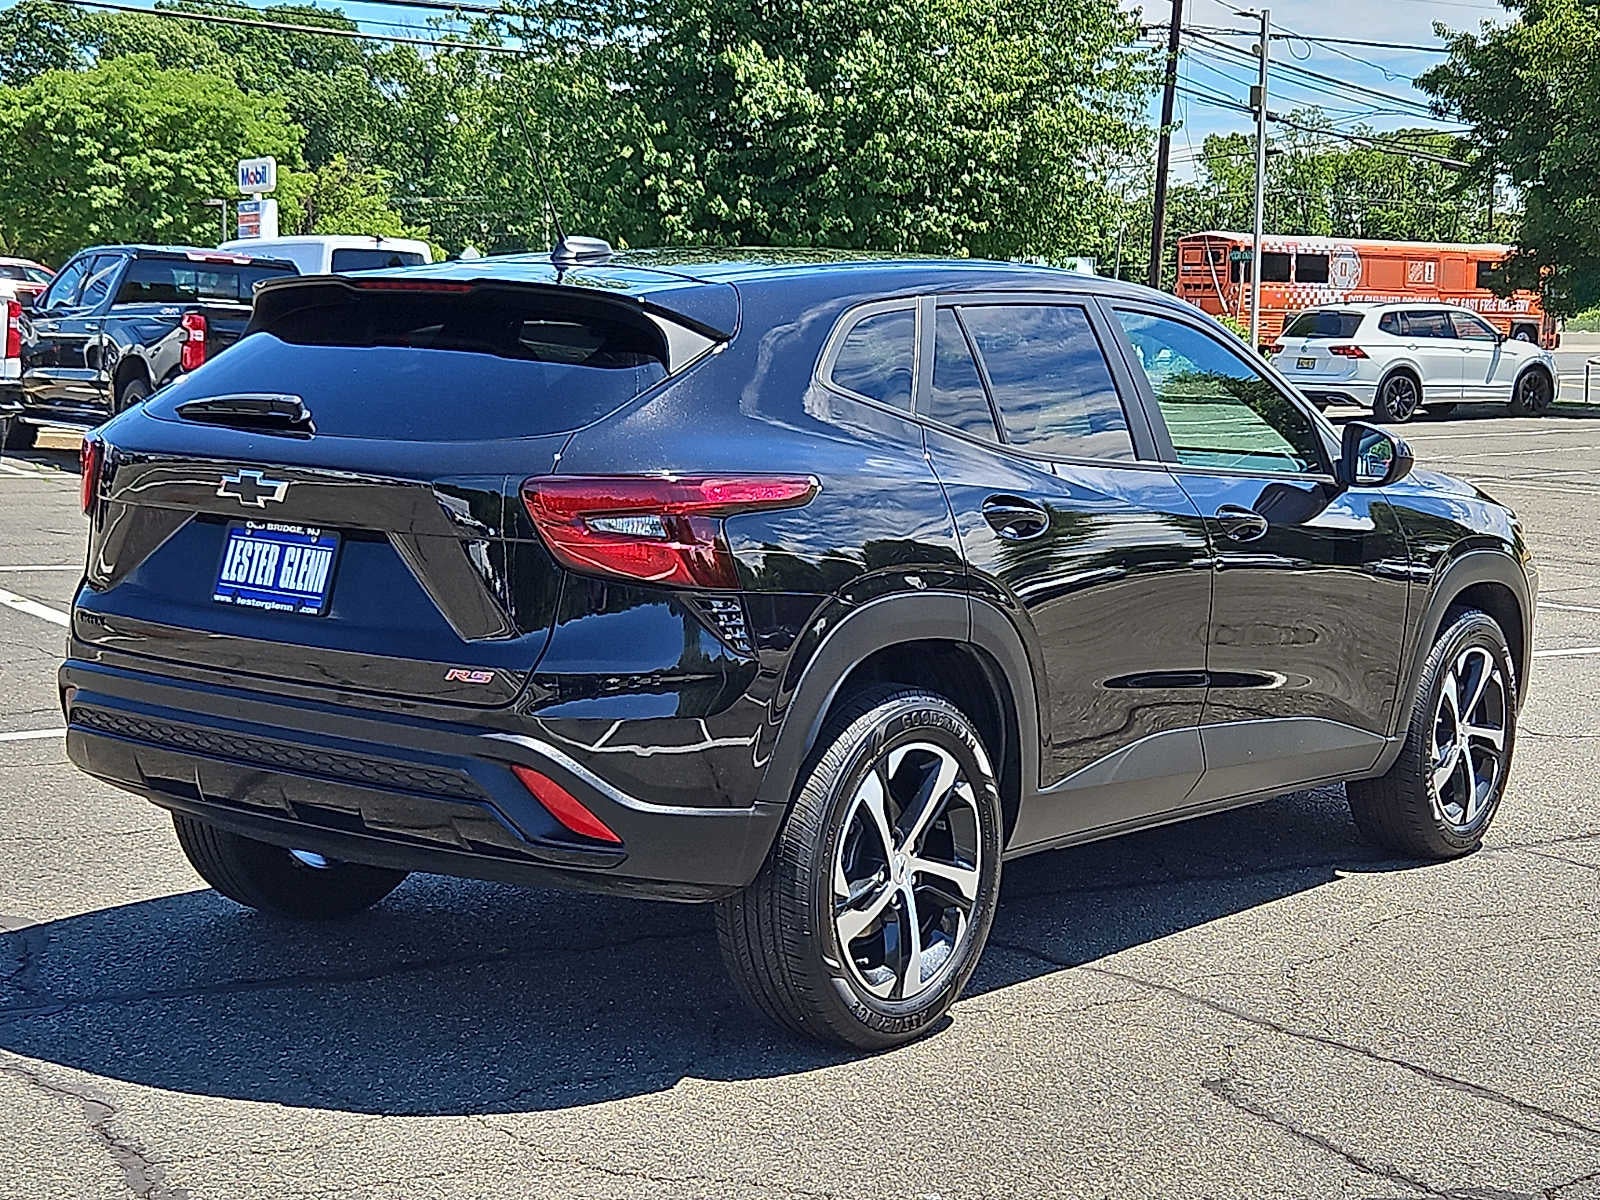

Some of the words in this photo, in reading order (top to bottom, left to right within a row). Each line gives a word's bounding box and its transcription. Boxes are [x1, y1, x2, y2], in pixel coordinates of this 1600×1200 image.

[241, 165, 267, 186] Mobil
[1480, 298, 1497, 312] FREE
[1497, 299, 1530, 313] DELERY
[266, 523, 305, 535] BRIDGE,
[307, 528, 321, 536] NJ
[221, 539, 280, 587] LESTER
[279, 547, 332, 593] GLENN
[236, 597, 294, 610] lesterglenn
[445, 669, 495, 684] RS
